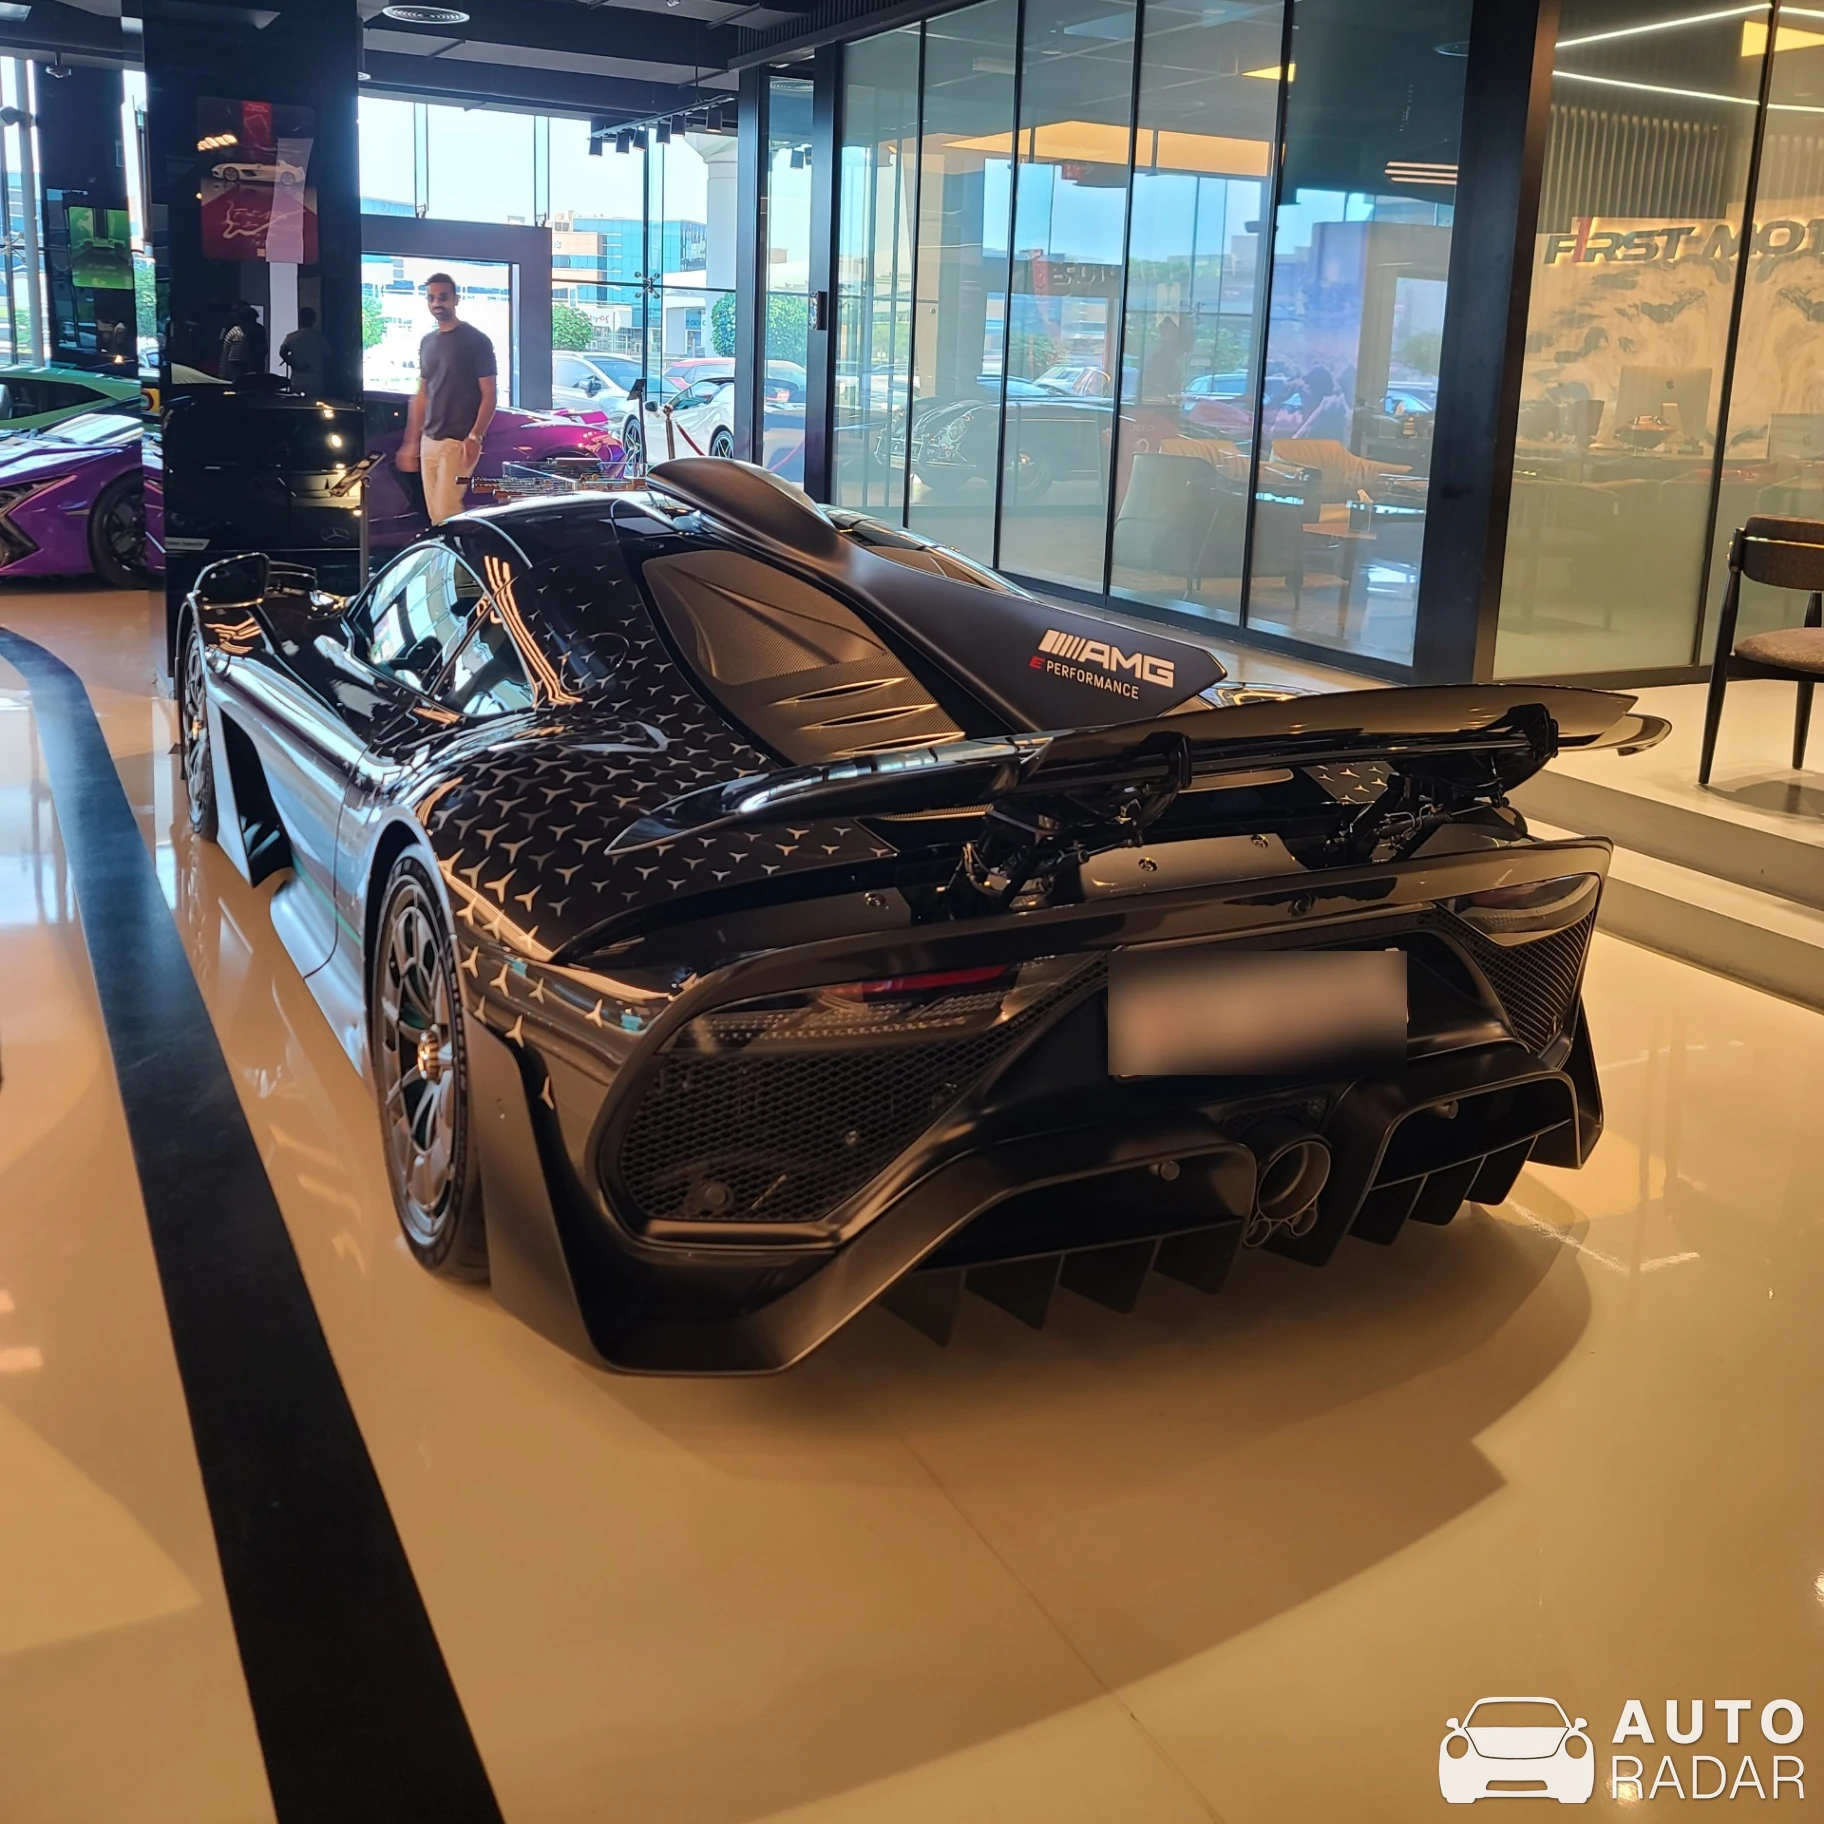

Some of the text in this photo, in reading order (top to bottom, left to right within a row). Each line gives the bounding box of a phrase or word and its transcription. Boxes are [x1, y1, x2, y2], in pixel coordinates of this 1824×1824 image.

[1702, 219, 1824, 258] MO
[1029, 655, 1140, 700] E PERFORMANCE
